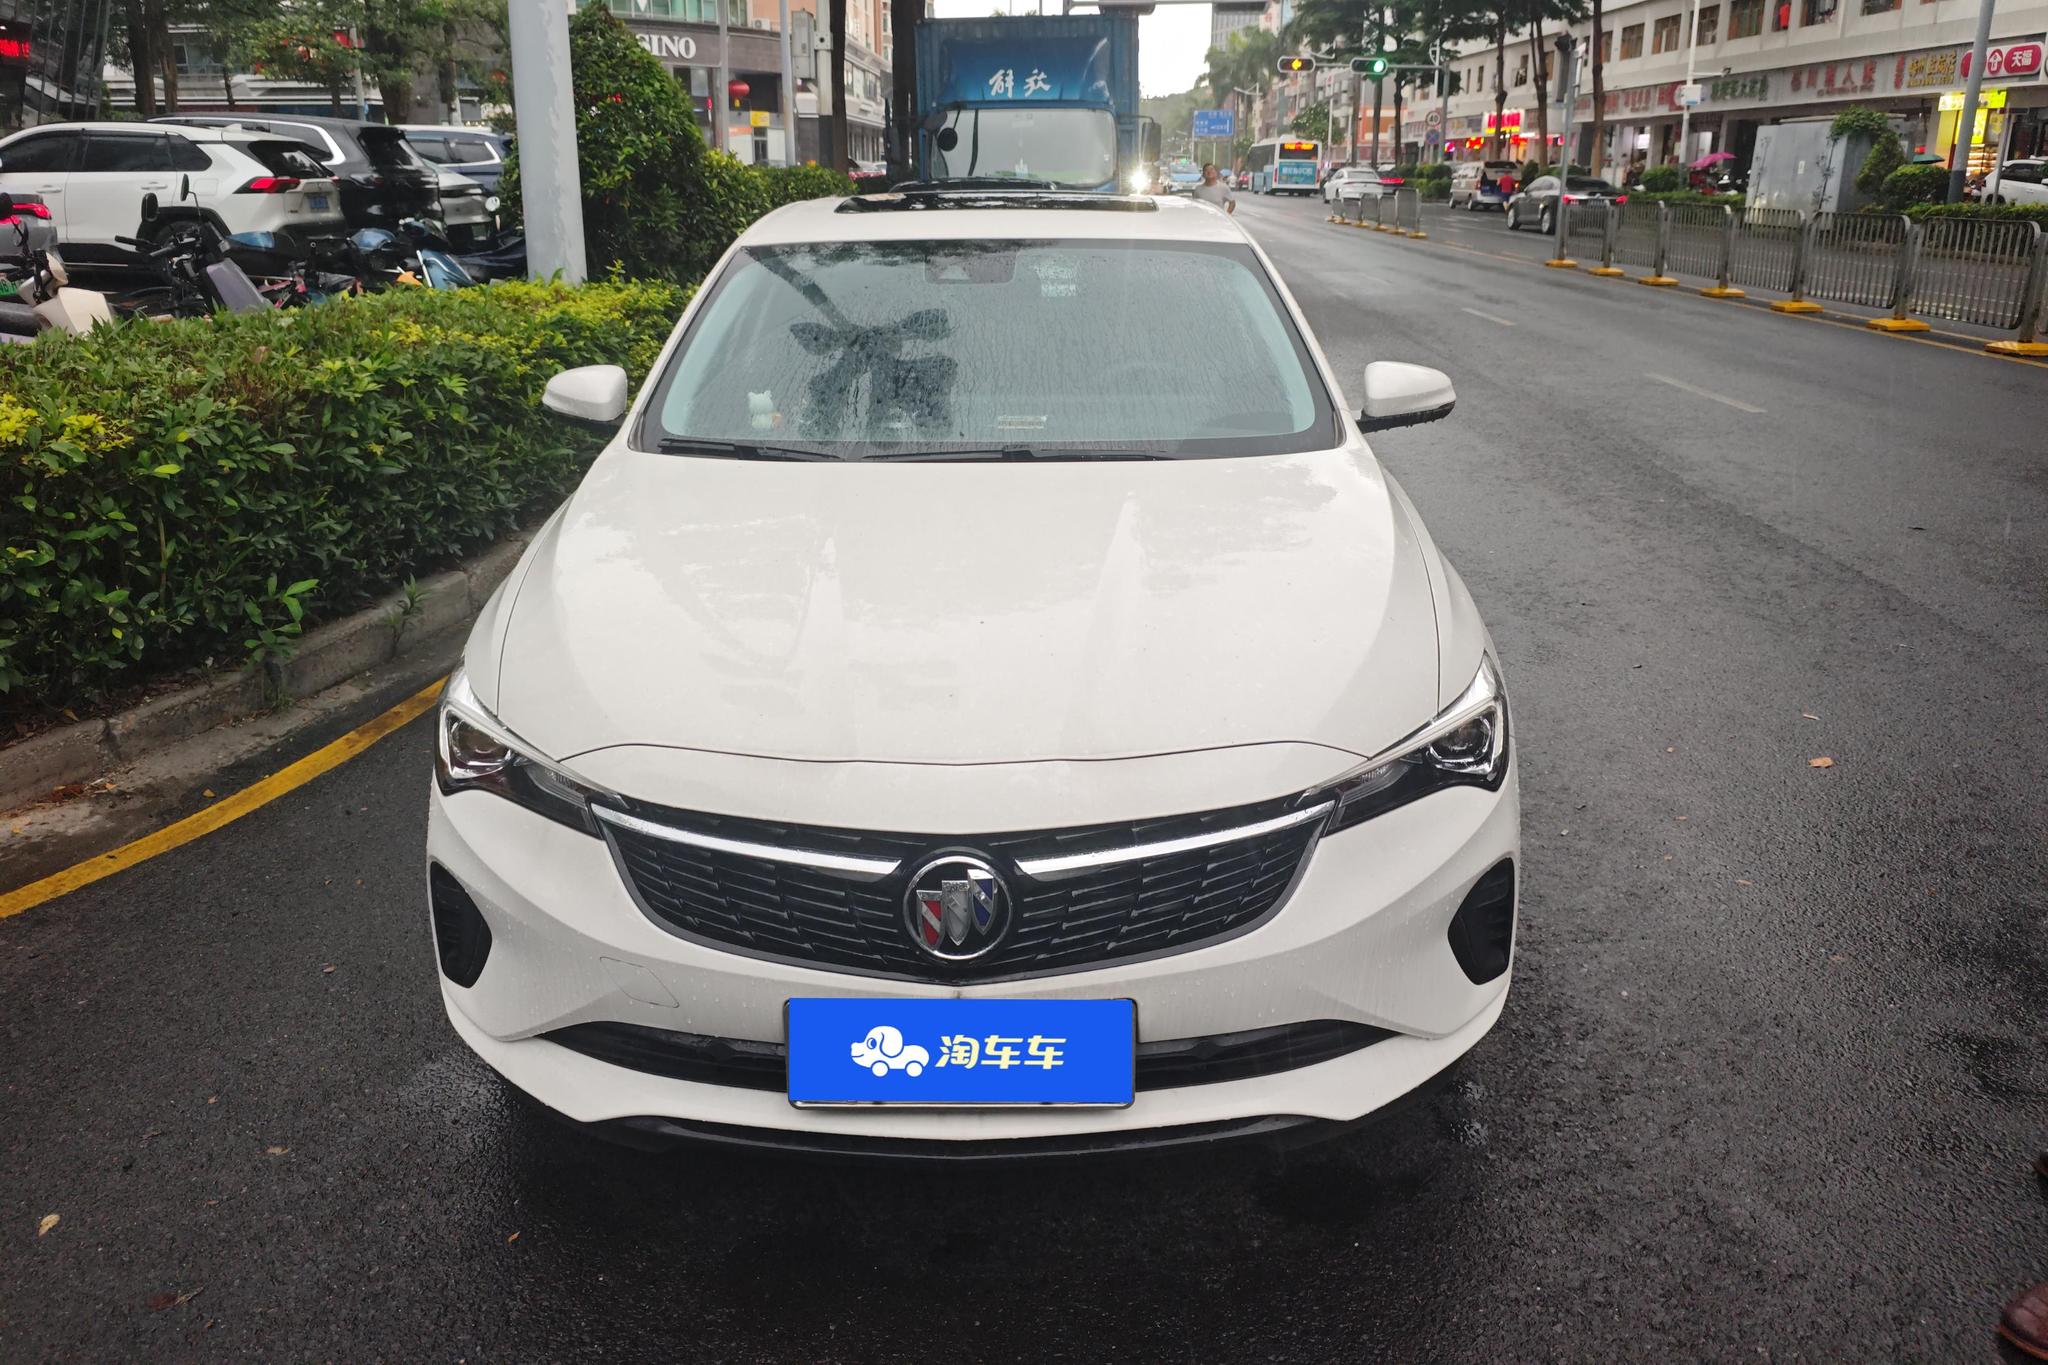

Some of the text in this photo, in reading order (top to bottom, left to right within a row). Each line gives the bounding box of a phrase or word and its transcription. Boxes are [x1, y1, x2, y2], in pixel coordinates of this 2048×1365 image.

[2011, 49, 2033, 67] 天福
[988, 68, 1052, 98] 解放
[1429, 114, 1439, 123] 40
